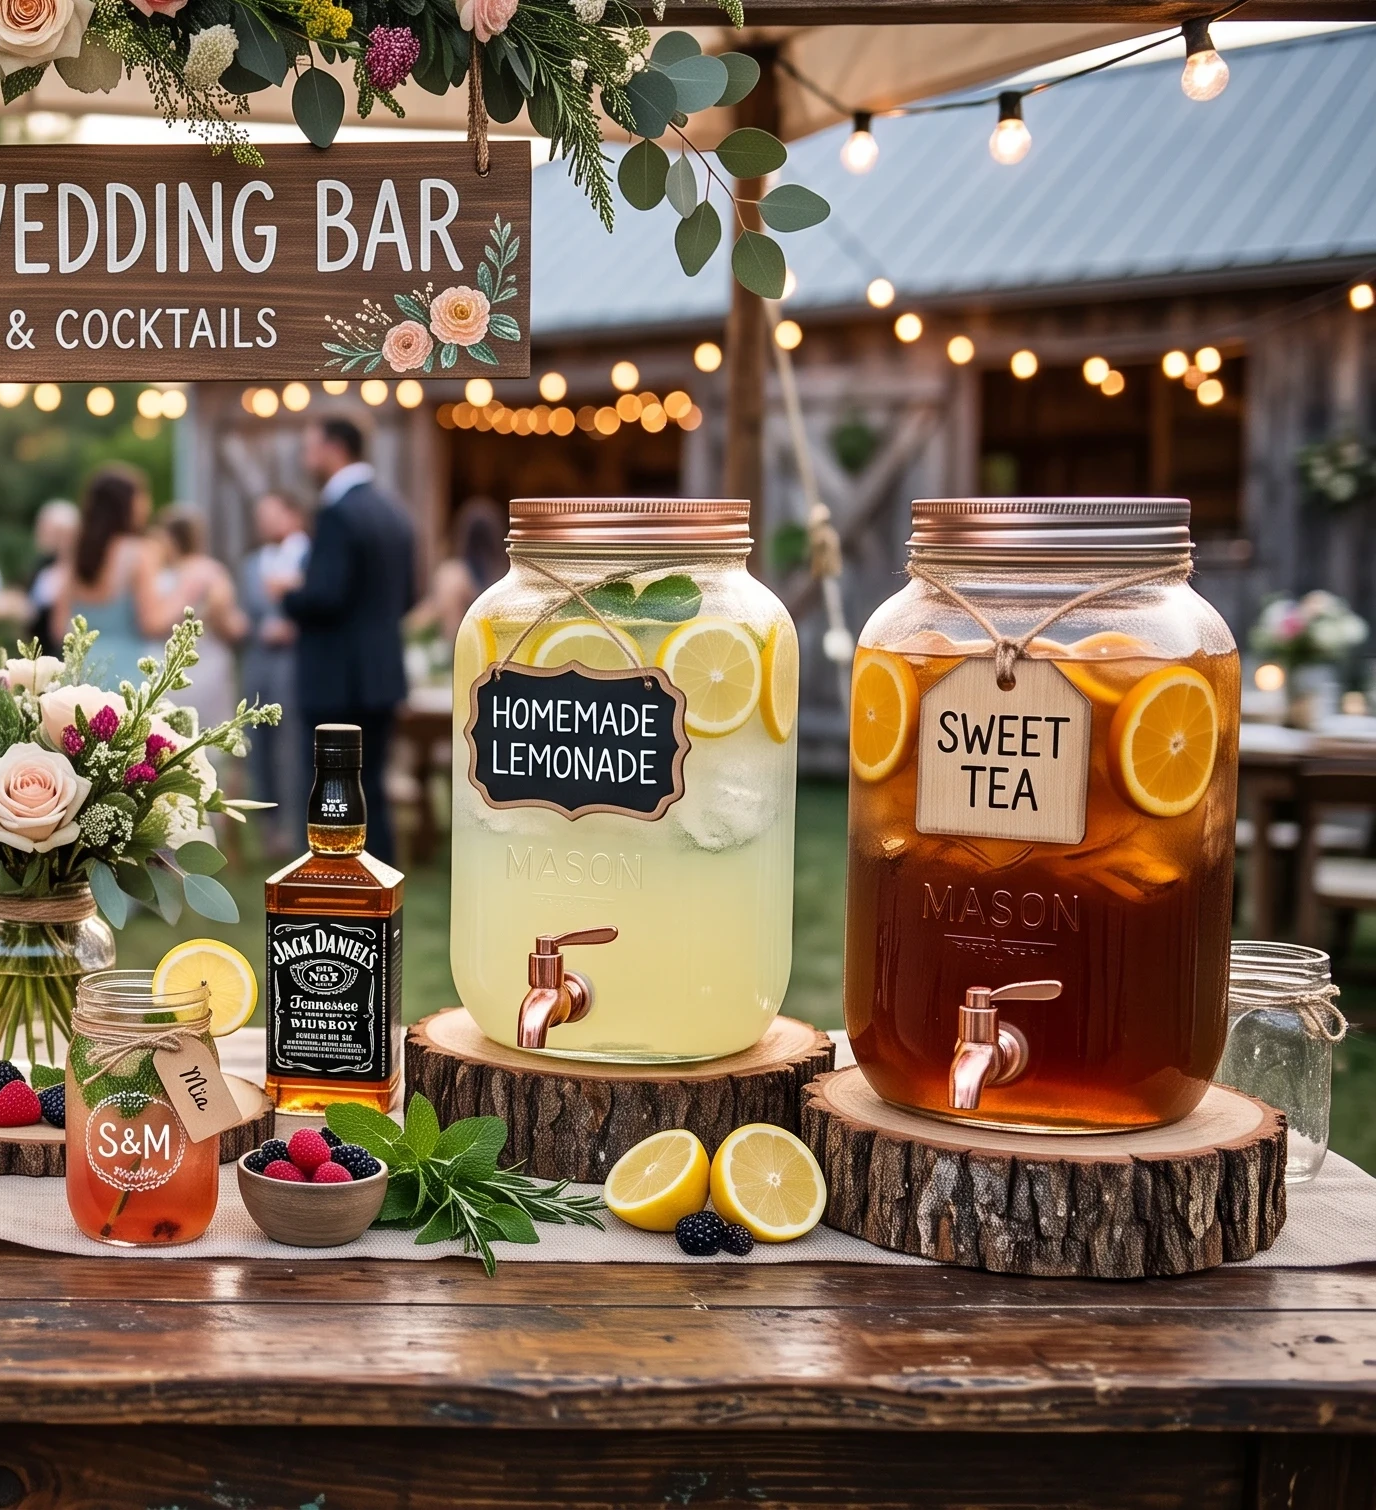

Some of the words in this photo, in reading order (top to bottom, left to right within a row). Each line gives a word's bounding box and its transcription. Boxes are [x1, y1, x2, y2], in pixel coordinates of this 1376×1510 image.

[316, 178, 464, 274] BAR
[5, 309, 36, 350] &
[55, 307, 279, 351] COCKTAILS
[492, 695, 659, 738] HOMEMADE
[937, 710, 1071, 760] SWEET
[492, 739, 658, 785] LEMONADE
[960, 764, 1038, 812] TEA
[505, 844, 643, 890] MASON
[922, 882, 1080, 932] MASON
[272, 934, 314, 966] JACK
[98, 1122, 170, 1160] S&M
